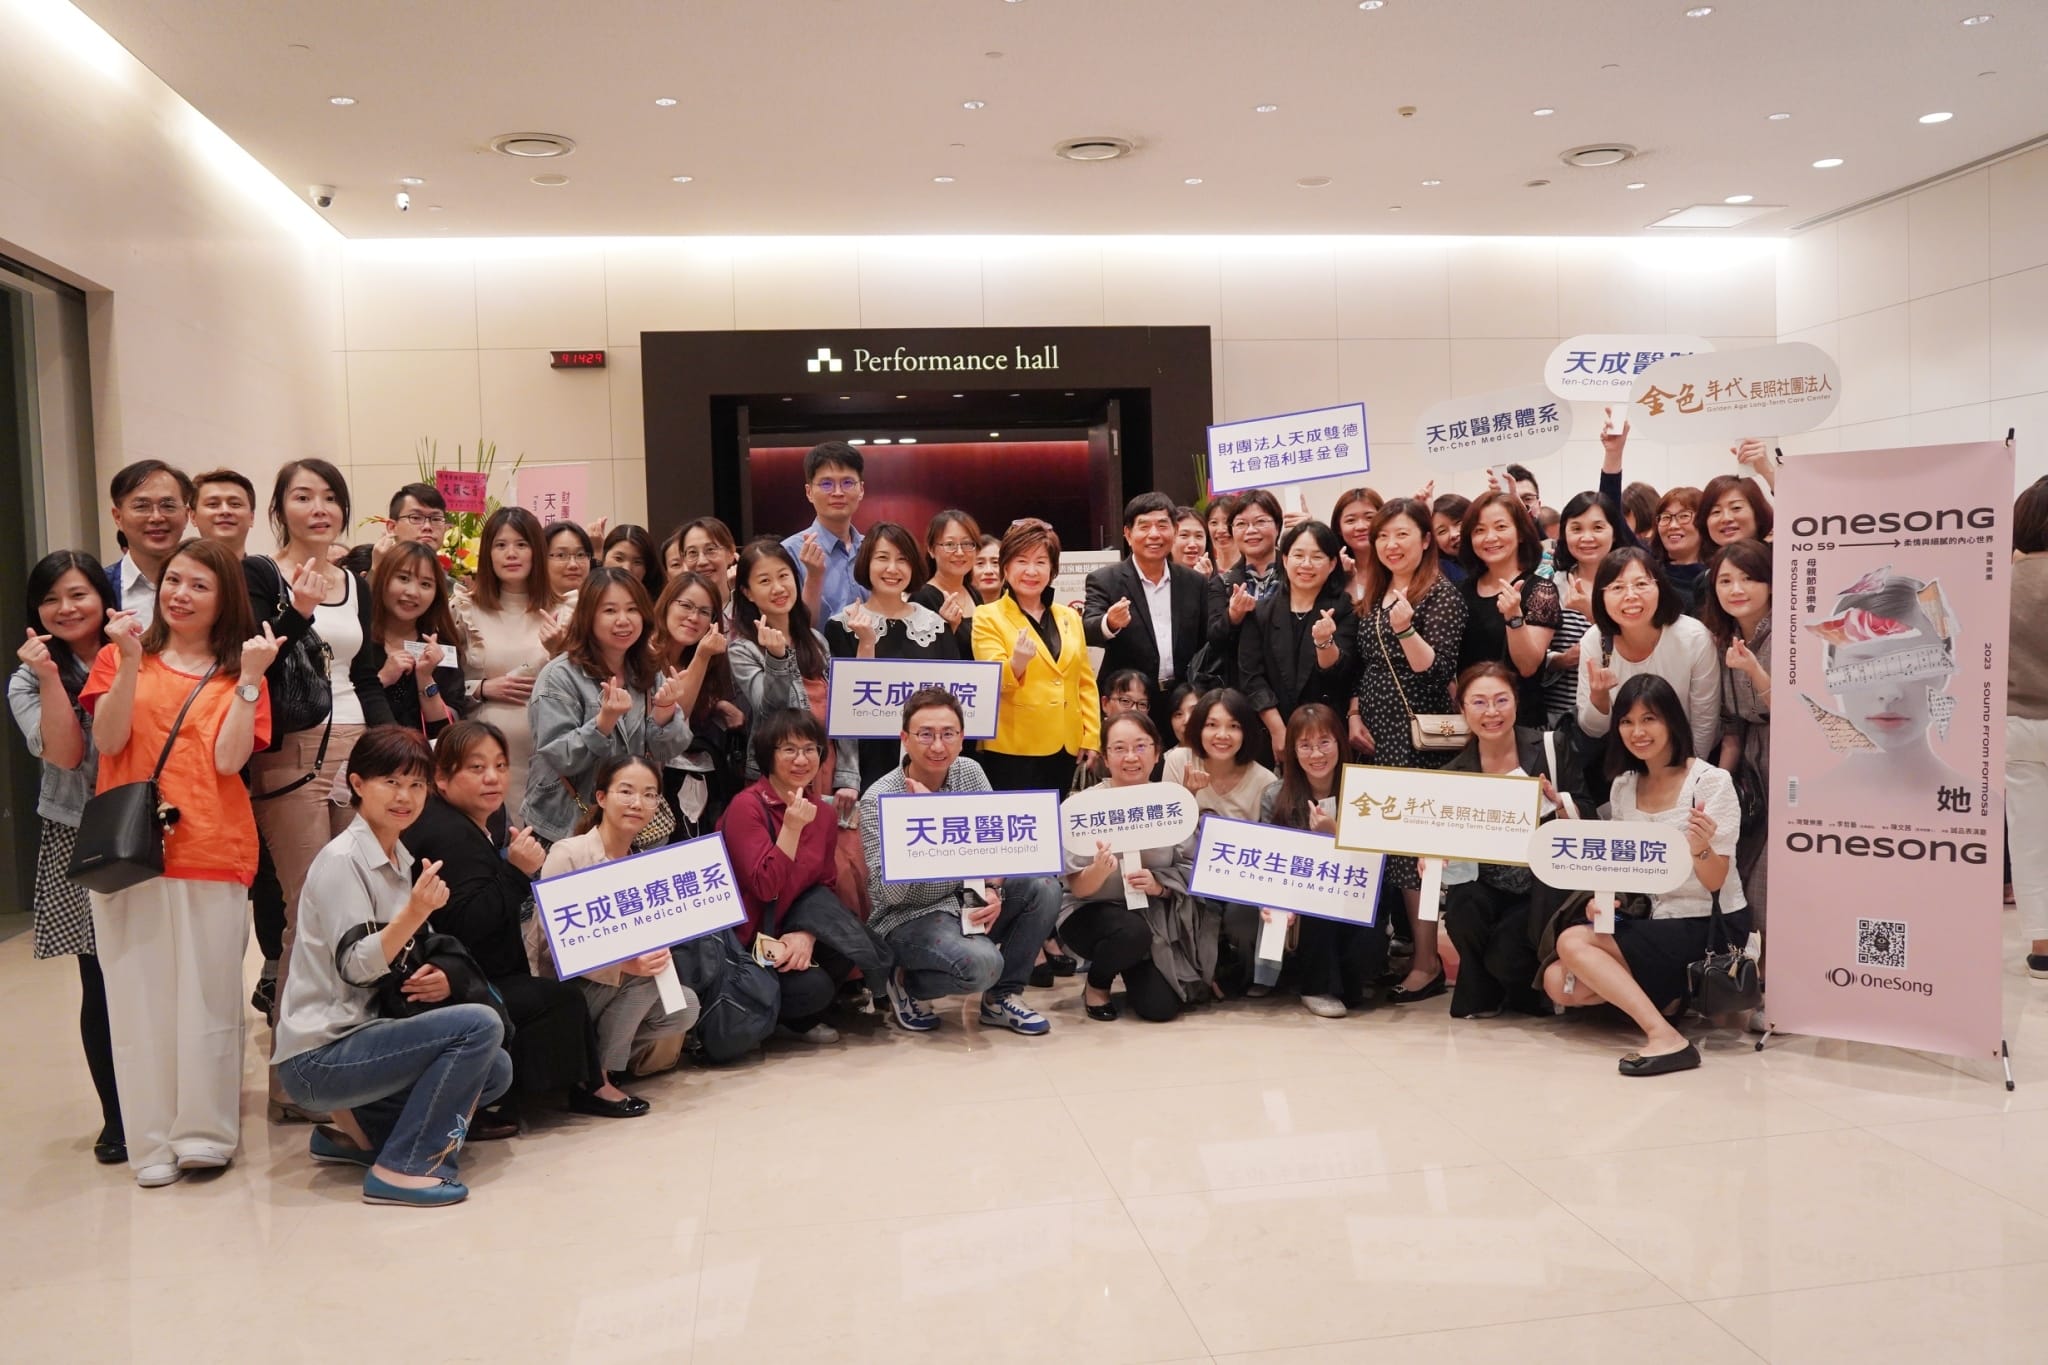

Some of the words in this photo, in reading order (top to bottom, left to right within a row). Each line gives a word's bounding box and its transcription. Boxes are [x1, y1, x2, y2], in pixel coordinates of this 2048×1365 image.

[854, 346, 1008, 372] Performance
[1015, 345, 1060, 370] hall
[1563, 351, 1694, 375] 天成醫
[1426, 403, 1559, 445] 天成醫療體系
[1428, 440, 1477, 454] Ten-Chen
[1481, 431, 1523, 444] Medical
[1527, 424, 1560, 436] Group
[1218, 423, 1359, 456] 財團法人天成雙德
[1230, 443, 1349, 473] 社會福利基金會
[1817, 542, 1836, 551] 59
[1806, 558, 1817, 613] 母親節音樂會
[852, 681, 977, 708] 天成院
[1937, 785, 1972, 813] 她
[906, 813, 1038, 846] 天晟醫院
[1070, 801, 1183, 831] 天成醫療體系
[1071, 827, 1114, 838] Ten-Chen
[1117, 821, 1153, 832] Medical
[1156, 818, 1184, 827] Group
[908, 848, 956, 858] Ten-Chan
[958, 845, 998, 856] General
[1000, 843, 1039, 855] Hospital
[1210, 841, 1369, 889] 天成生醫科技
[1551, 837, 1667, 864] 天晟醫院
[1208, 864, 1230, 876] Ten
[1239, 870, 1274, 883] Chen
[1282, 878, 1366, 900] BioMedical
[1551, 862, 1593, 871] Ten-Chan
[1594, 864, 1631, 873] General
[1632, 866, 1669, 876] Hospital
[553, 862, 729, 936] 天成醫療體系
[560, 920, 629, 949] Ten-Chen
[633, 903, 688, 926] Medical
[692, 889, 732, 909] Group
[1860, 973, 1933, 997] OneSong
